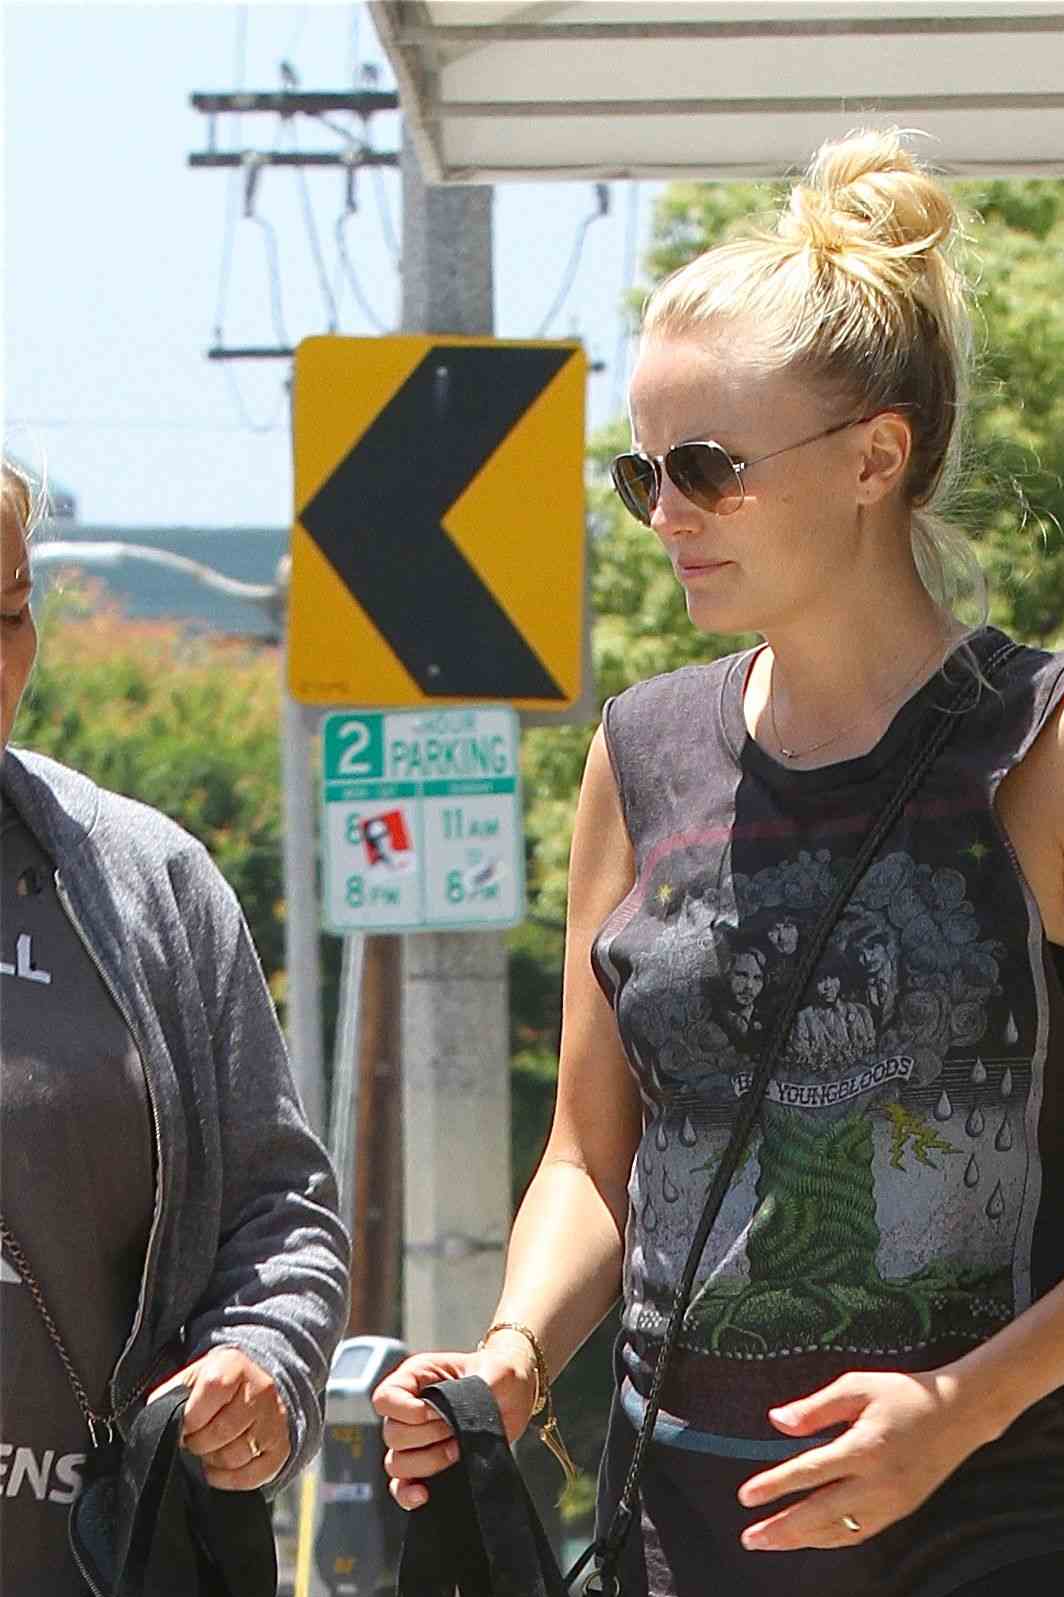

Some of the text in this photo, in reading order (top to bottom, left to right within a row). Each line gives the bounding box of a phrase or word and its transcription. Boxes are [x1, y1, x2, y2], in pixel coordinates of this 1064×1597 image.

[337, 721, 508, 775] 2 PARKING
[345, 874, 364, 909] 8
[776, 1056, 912, 1106] YOUNGBLOODS
